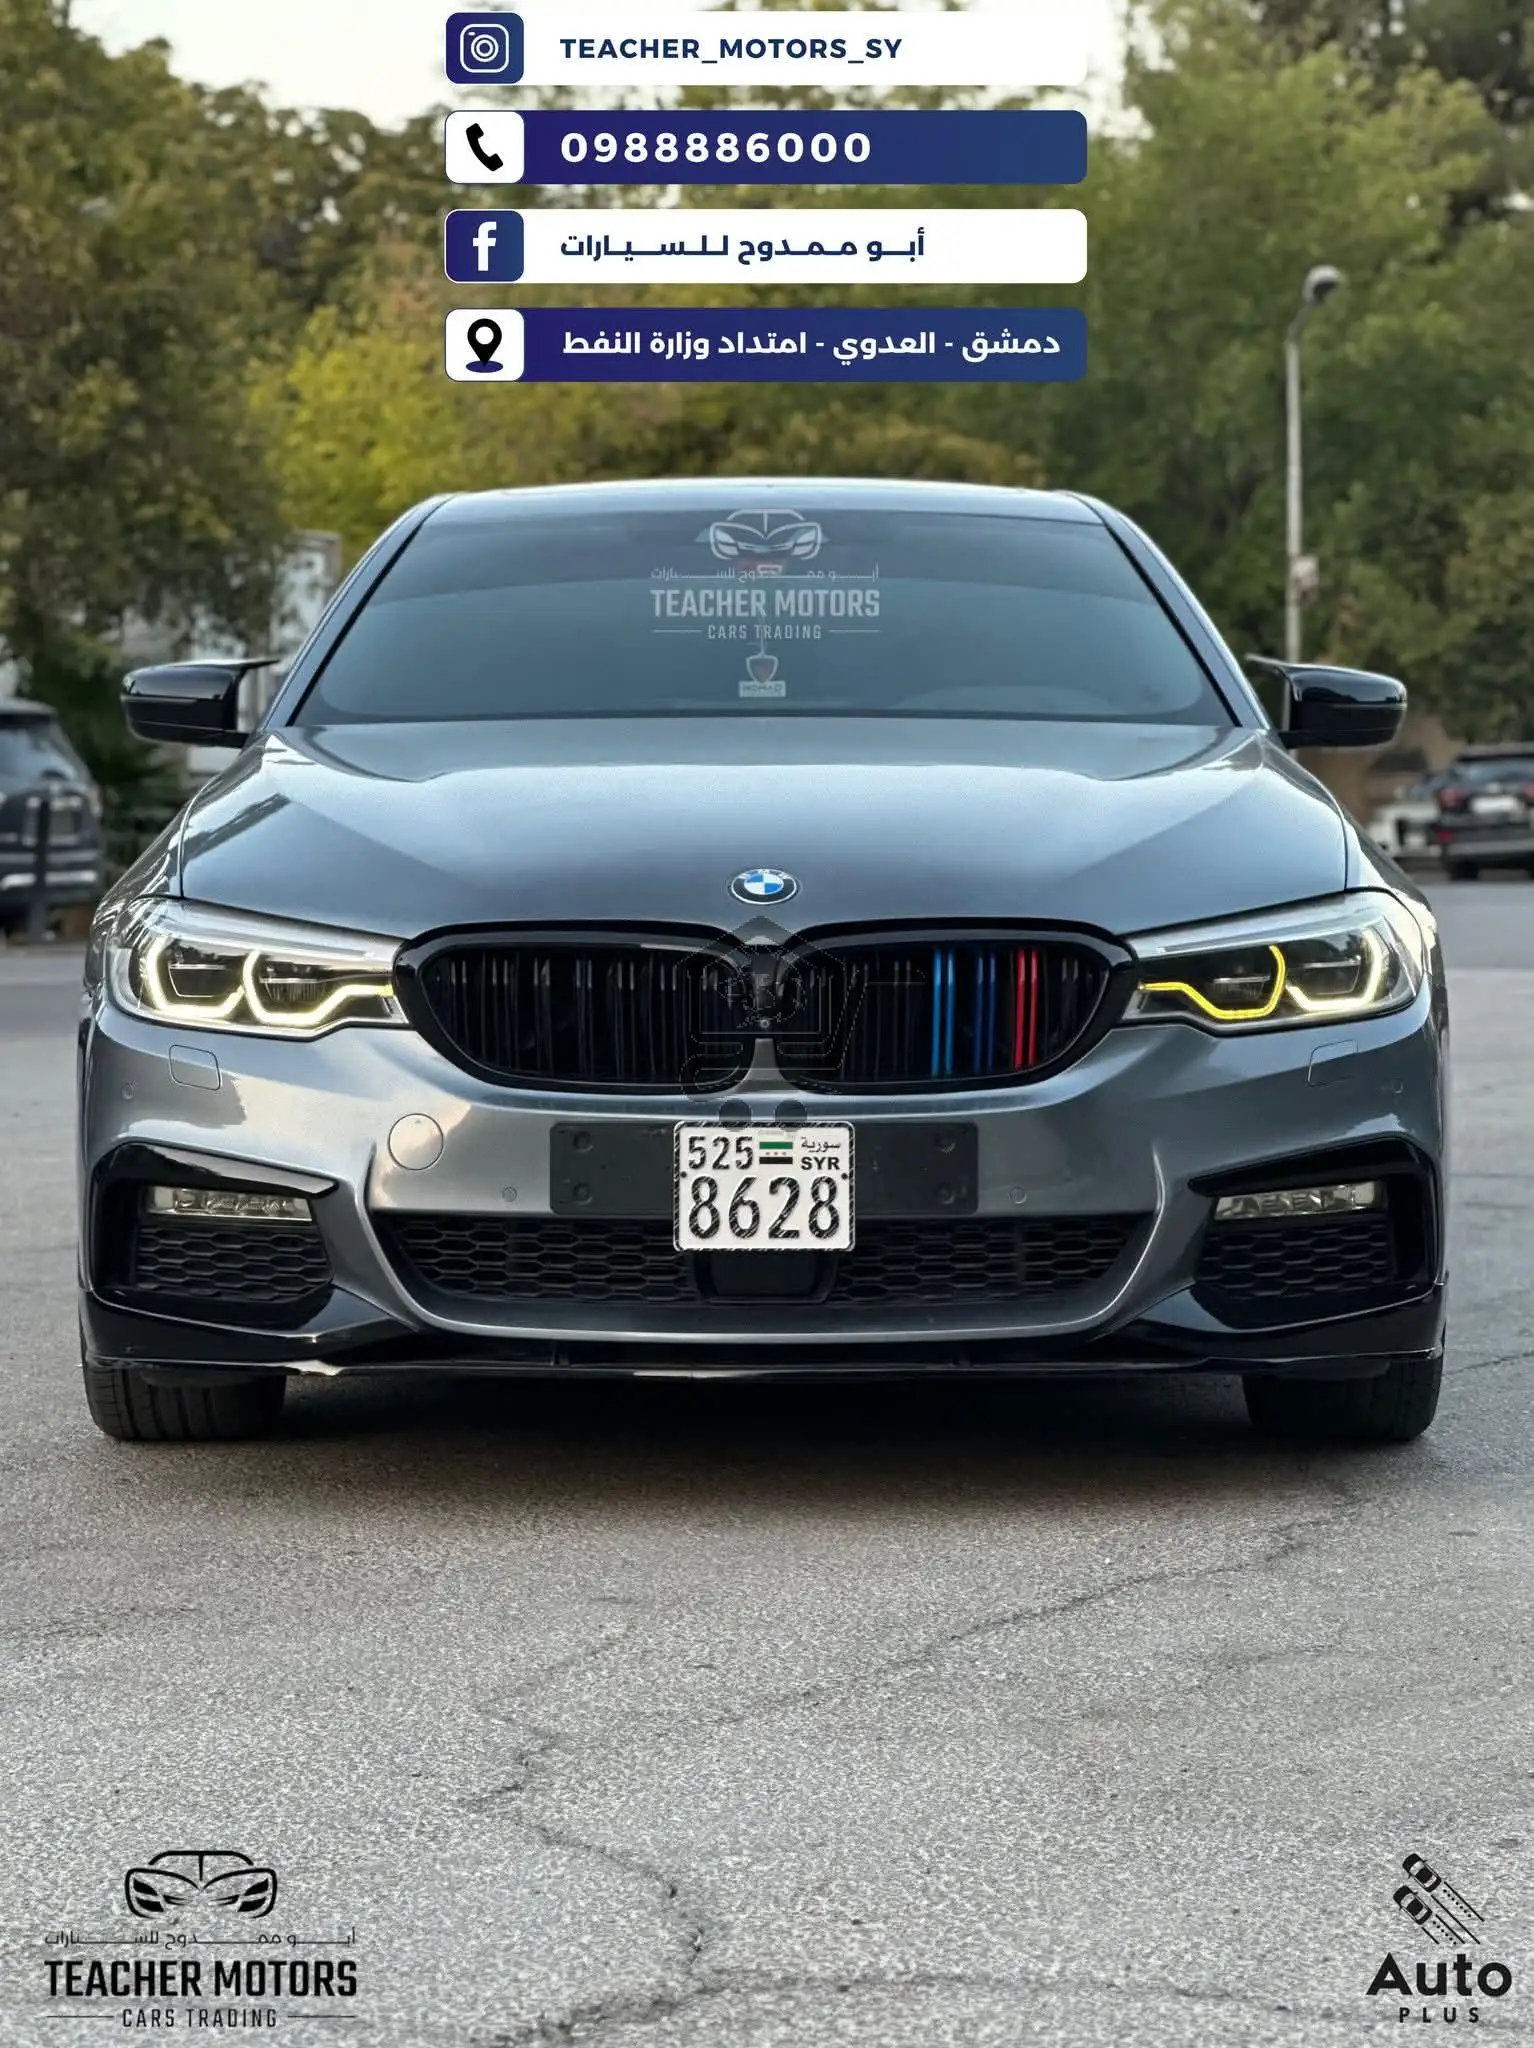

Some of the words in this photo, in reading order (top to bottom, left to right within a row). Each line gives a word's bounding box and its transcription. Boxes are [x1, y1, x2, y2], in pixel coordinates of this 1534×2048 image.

[688, 1136, 754, 1170] 525
[800, 1135, 842, 1153] سورية
[801, 1156, 841, 1171] SYR
[688, 1175, 841, 1240] 8628
